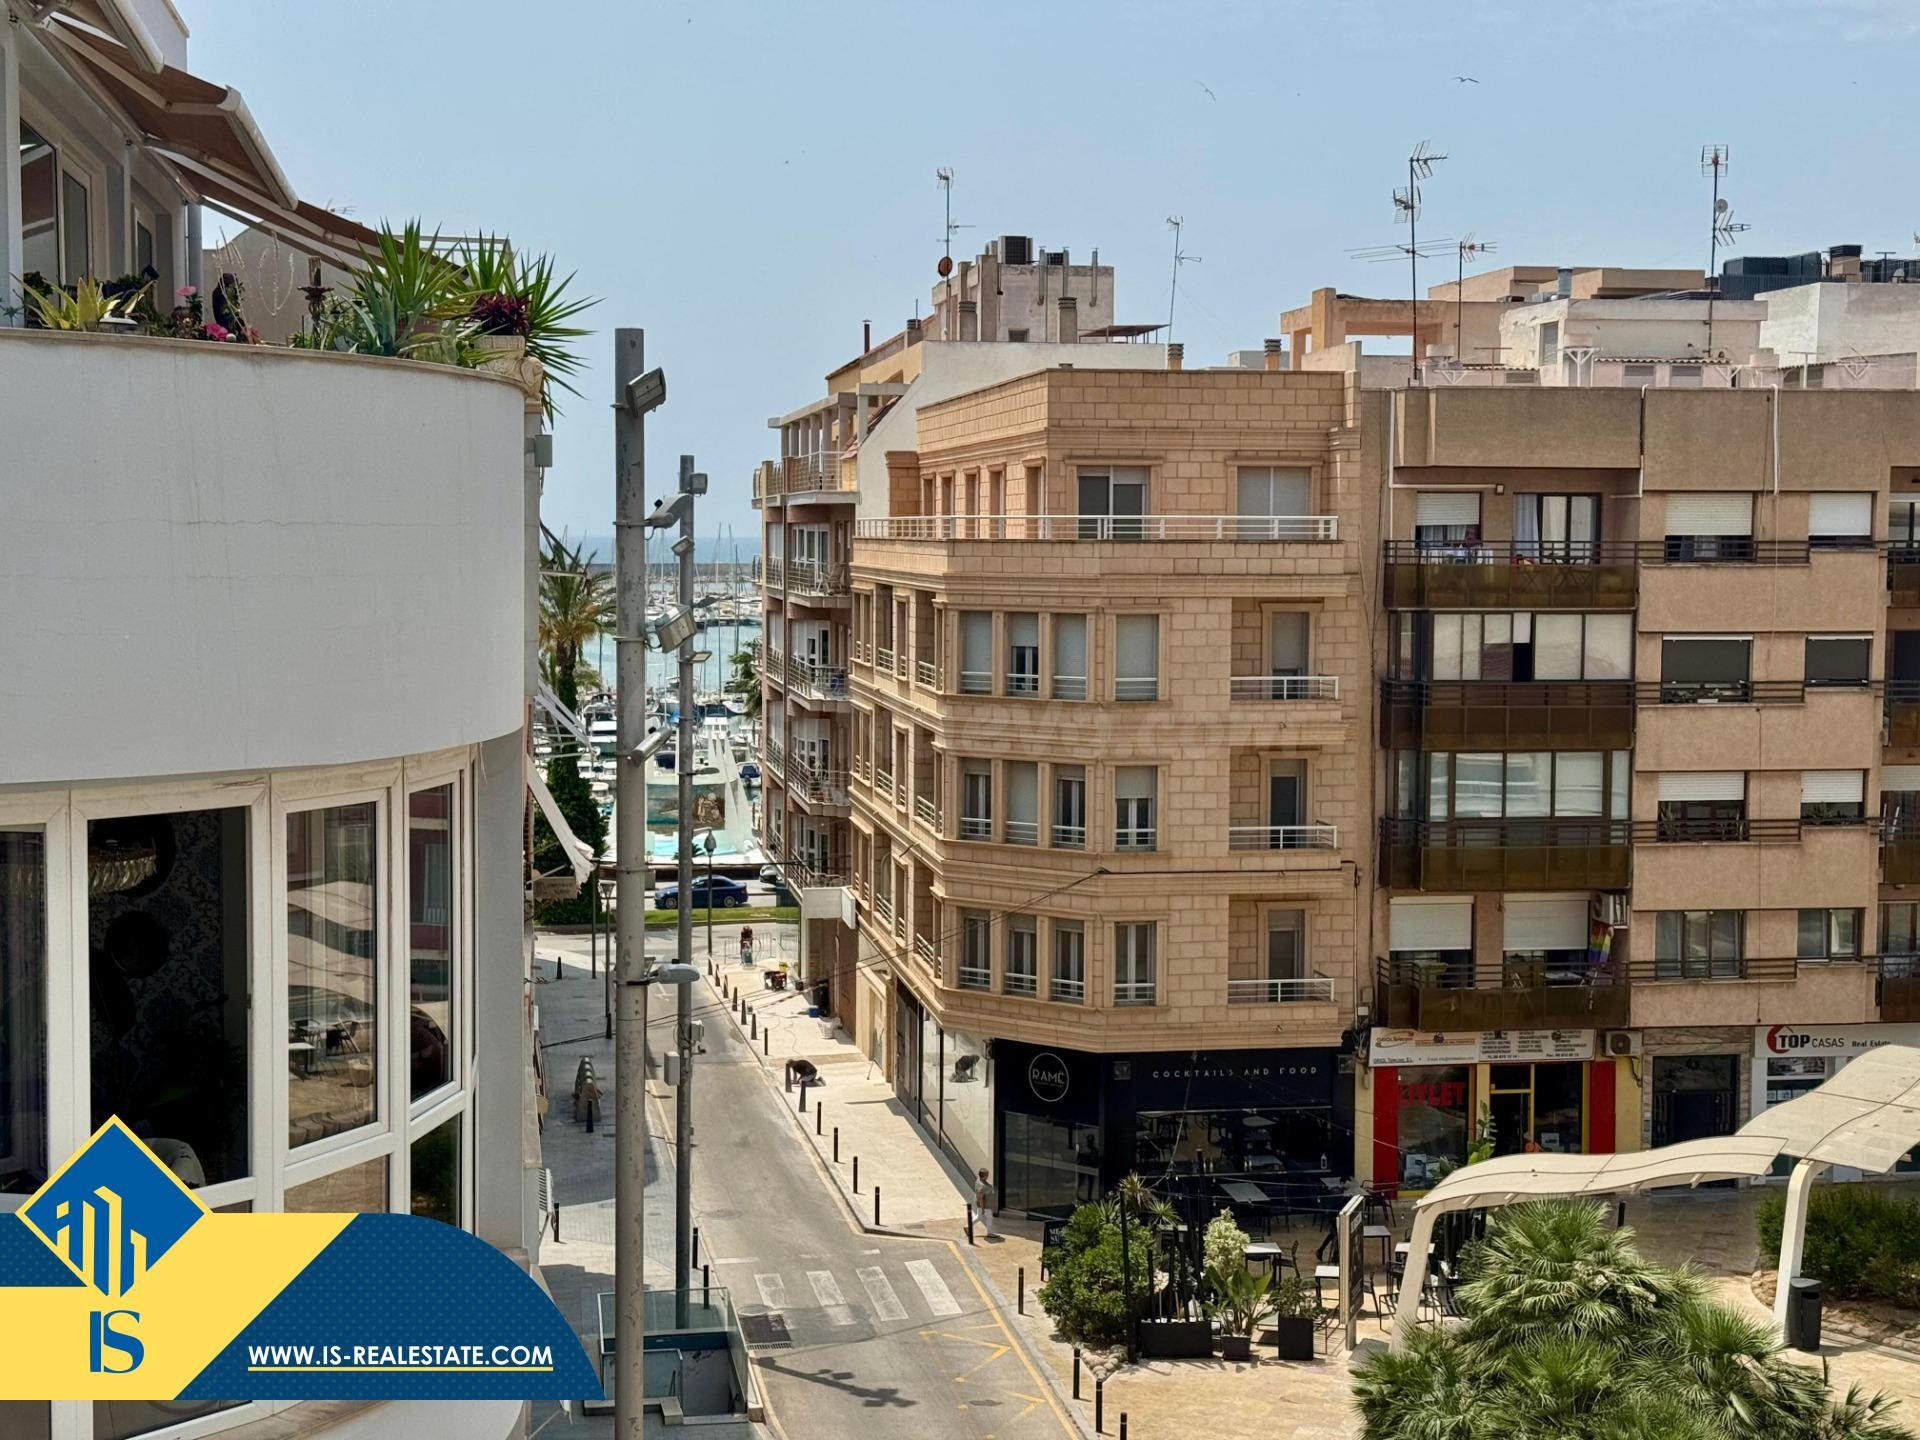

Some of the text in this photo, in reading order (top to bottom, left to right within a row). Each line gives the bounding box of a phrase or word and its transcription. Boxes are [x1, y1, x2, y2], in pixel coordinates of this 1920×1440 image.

[1778, 1034, 1845, 1048] TOP CASAS
[1851, 1040, 1868, 1048] Real
[1152, 1066, 1318, 1078] COCKTAILS AND FOOD
